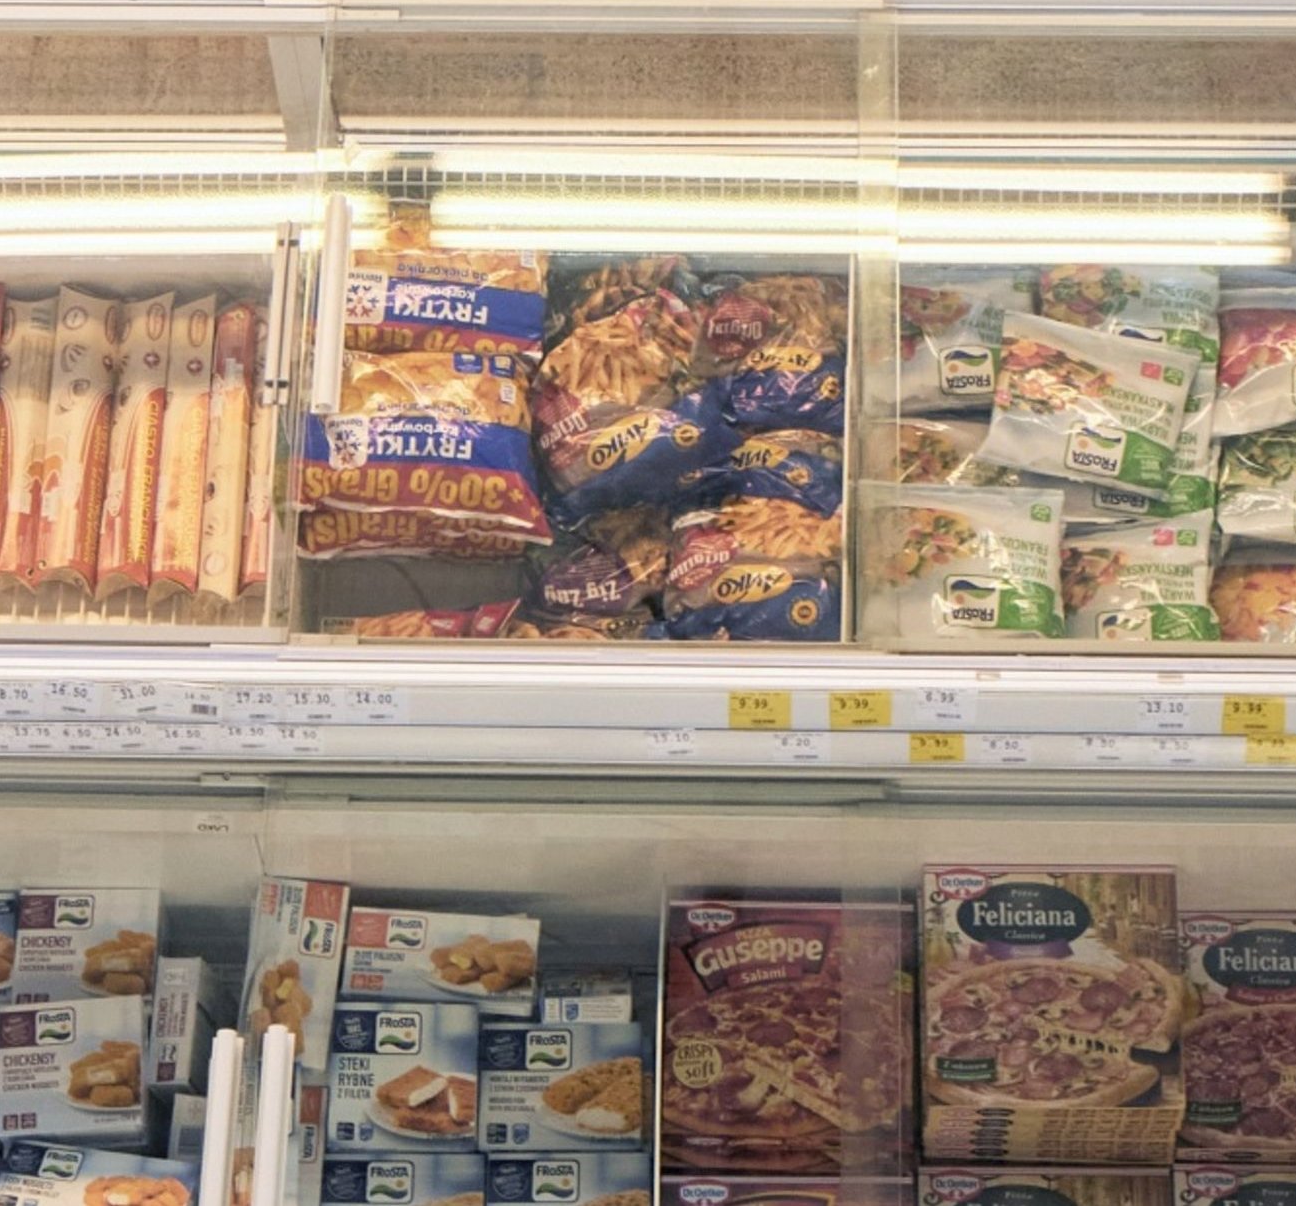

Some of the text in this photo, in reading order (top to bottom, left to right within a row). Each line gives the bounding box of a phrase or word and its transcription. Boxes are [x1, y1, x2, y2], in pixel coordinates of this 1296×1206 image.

[394, 300, 489, 324] FRYTKI
[375, 437, 472, 460] FRYTKI
[237, 692, 273, 704] 17.20
[294, 693, 331, 704] 15.30
[356, 693, 392, 704] 14.00
[738, 699, 768, 710] 9.99
[839, 699, 869, 710] 9.99
[1146, 702, 1184, 714] 13.10
[1232, 703, 1262, 714] 9.99
[14, 727, 50, 736] 13.75
[973, 901, 1077, 927] Feliciana
[1004, 929, 1046, 940] Classica
[20, 935, 72, 950] CHICKENSY
[694, 936, 824, 977] Guseppe
[742, 965, 786, 984] Salami
[677, 1043, 714, 1060] CRISPY
[3, 1053, 55, 1068] CHICKENSY
[339, 1057, 370, 1071] STEKI
[338, 1073, 375, 1088] RYBNE
